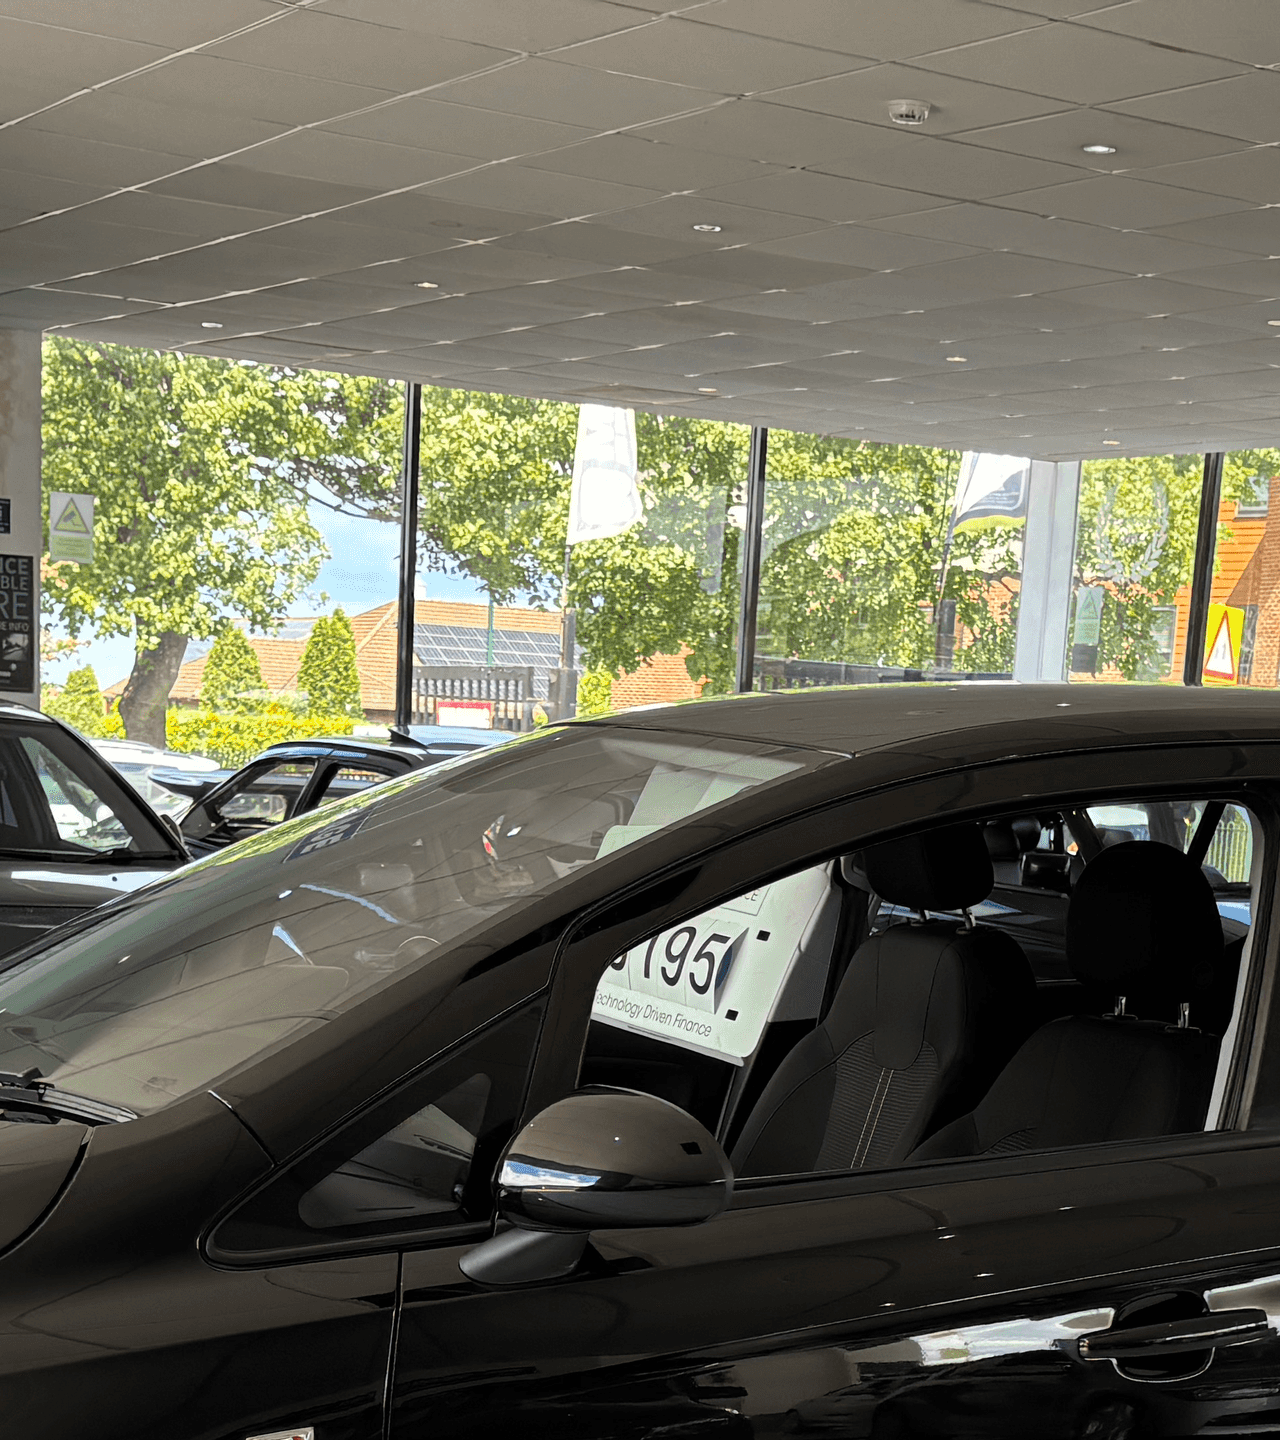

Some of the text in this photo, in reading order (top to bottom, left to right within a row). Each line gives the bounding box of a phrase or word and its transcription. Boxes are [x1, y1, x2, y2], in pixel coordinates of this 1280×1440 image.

[8, 622, 29, 632] INFO
[595, 990, 713, 1037] echnology Driven Finance
